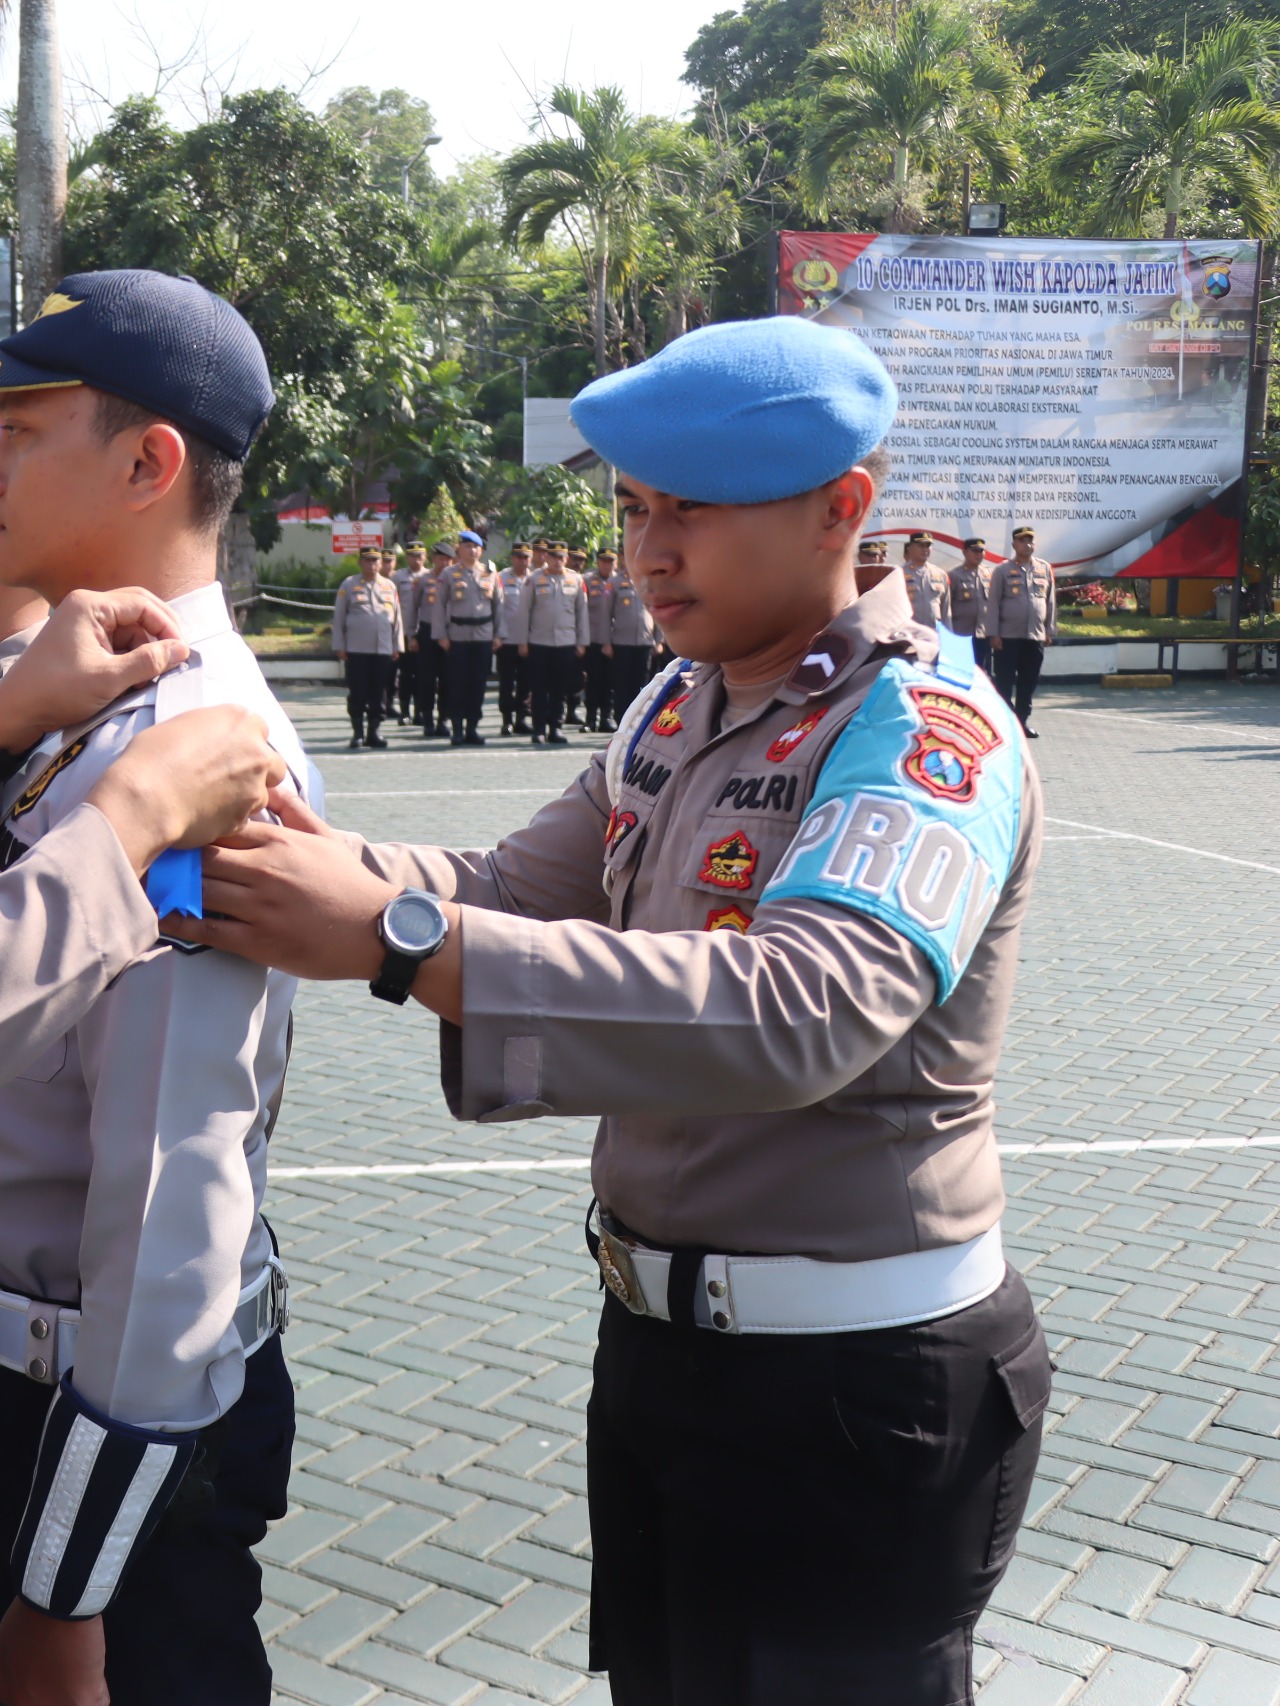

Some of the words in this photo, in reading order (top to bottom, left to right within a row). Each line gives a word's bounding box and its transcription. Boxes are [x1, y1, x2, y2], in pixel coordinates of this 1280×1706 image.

[858, 257, 873, 289] 10
[880, 258, 986, 292] COMMANDER
[992, 261, 1036, 293] WISH
[1041, 260, 1118, 293] KAPOLDA
[1124, 262, 1175, 295] JATIM
[894, 298, 931, 311] IRJEN
[937, 298, 960, 311] POL
[966, 299, 989, 312] Drs.
[994, 299, 1027, 313] IMAM
[1033, 300, 1103, 316] SUGIANTO,
[1107, 301, 1138, 314] M.Si.
[1127, 321, 1179, 331] POLRES
[1188, 321, 1244, 330] MALANG
[872, 329, 926, 339] KETAQWAAN
[930, 330, 974, 340] TERHADAP
[978, 331, 1008, 340] TUHAN
[1010, 332, 1033, 341] YANG
[1036, 333, 1062, 342] MAHA
[1064, 333, 1081, 342] ESA.
[871, 347, 905, 356] MANAN
[909, 348, 952, 358] PROGRAM
[955, 349, 998, 358] PRIORITAS
[1002, 350, 1045, 359] NASIONAL
[1048, 350, 1057, 360] DI
[1059, 350, 1083, 360] JAWA
[903, 365, 953, 375] RANGKAIAN
[957, 366, 1003, 376] PEMILIHAN
[1007, 367, 1033, 377] UMUM
[1036, 367, 1074, 378] (PEMILU)
[1076, 369, 1118, 378] SERENTAK
[1120, 369, 1150, 378] TAHUN
[915, 384, 964, 394] PELAYANAN
[968, 385, 993, 394] POLRI
[995, 385, 1040, 395] TERHADAP
[908, 401, 951, 411] INTERNAL
[954, 402, 972, 412] DAN
[975, 402, 1029, 413] KOLABORASI
[909, 419, 961, 430] PENEGAKAN
[891, 437, 920, 447] SOSIAL
[924, 437, 959, 447] SEBAGAI
[962, 438, 1002, 448] COOLING
[1005, 438, 1038, 448] SYSTEM
[1041, 439, 1069, 448] DALAM
[1073, 439, 1106, 449] RANGKA
[1110, 439, 1149, 449] MENJAGA
[1152, 439, 1175, 449] SERTA
[1178, 440, 1218, 449] MERAWAT
[908, 455, 935, 464] TIMUR
[938, 455, 961, 465] YANG
[964, 456, 1016, 466] MERUPAKAN
[1019, 456, 1060, 466] MINIATUR
[912, 473, 951, 482] MITIGASI
[954, 473, 995, 483] BENCANA
[998, 474, 1015, 483] DAN
[1018, 474, 1075, 484] MEMPERKUAT
[1078, 475, 1117, 484] KESIAPAN
[1120, 475, 1177, 484] PENANGANAN
[926, 491, 943, 500] DAN
[946, 491, 995, 501] MORALITAS
[998, 491, 1031, 501] SUMBER
[1034, 492, 1055, 502] DAYA
[930, 508, 976, 518] TERHADAP
[978, 509, 1012, 519] KINERJA
[1016, 509, 1032, 519] DAN
[1036, 510, 1093, 519] KEDISIPLINAN
[716, 774, 798, 811] POLRI
